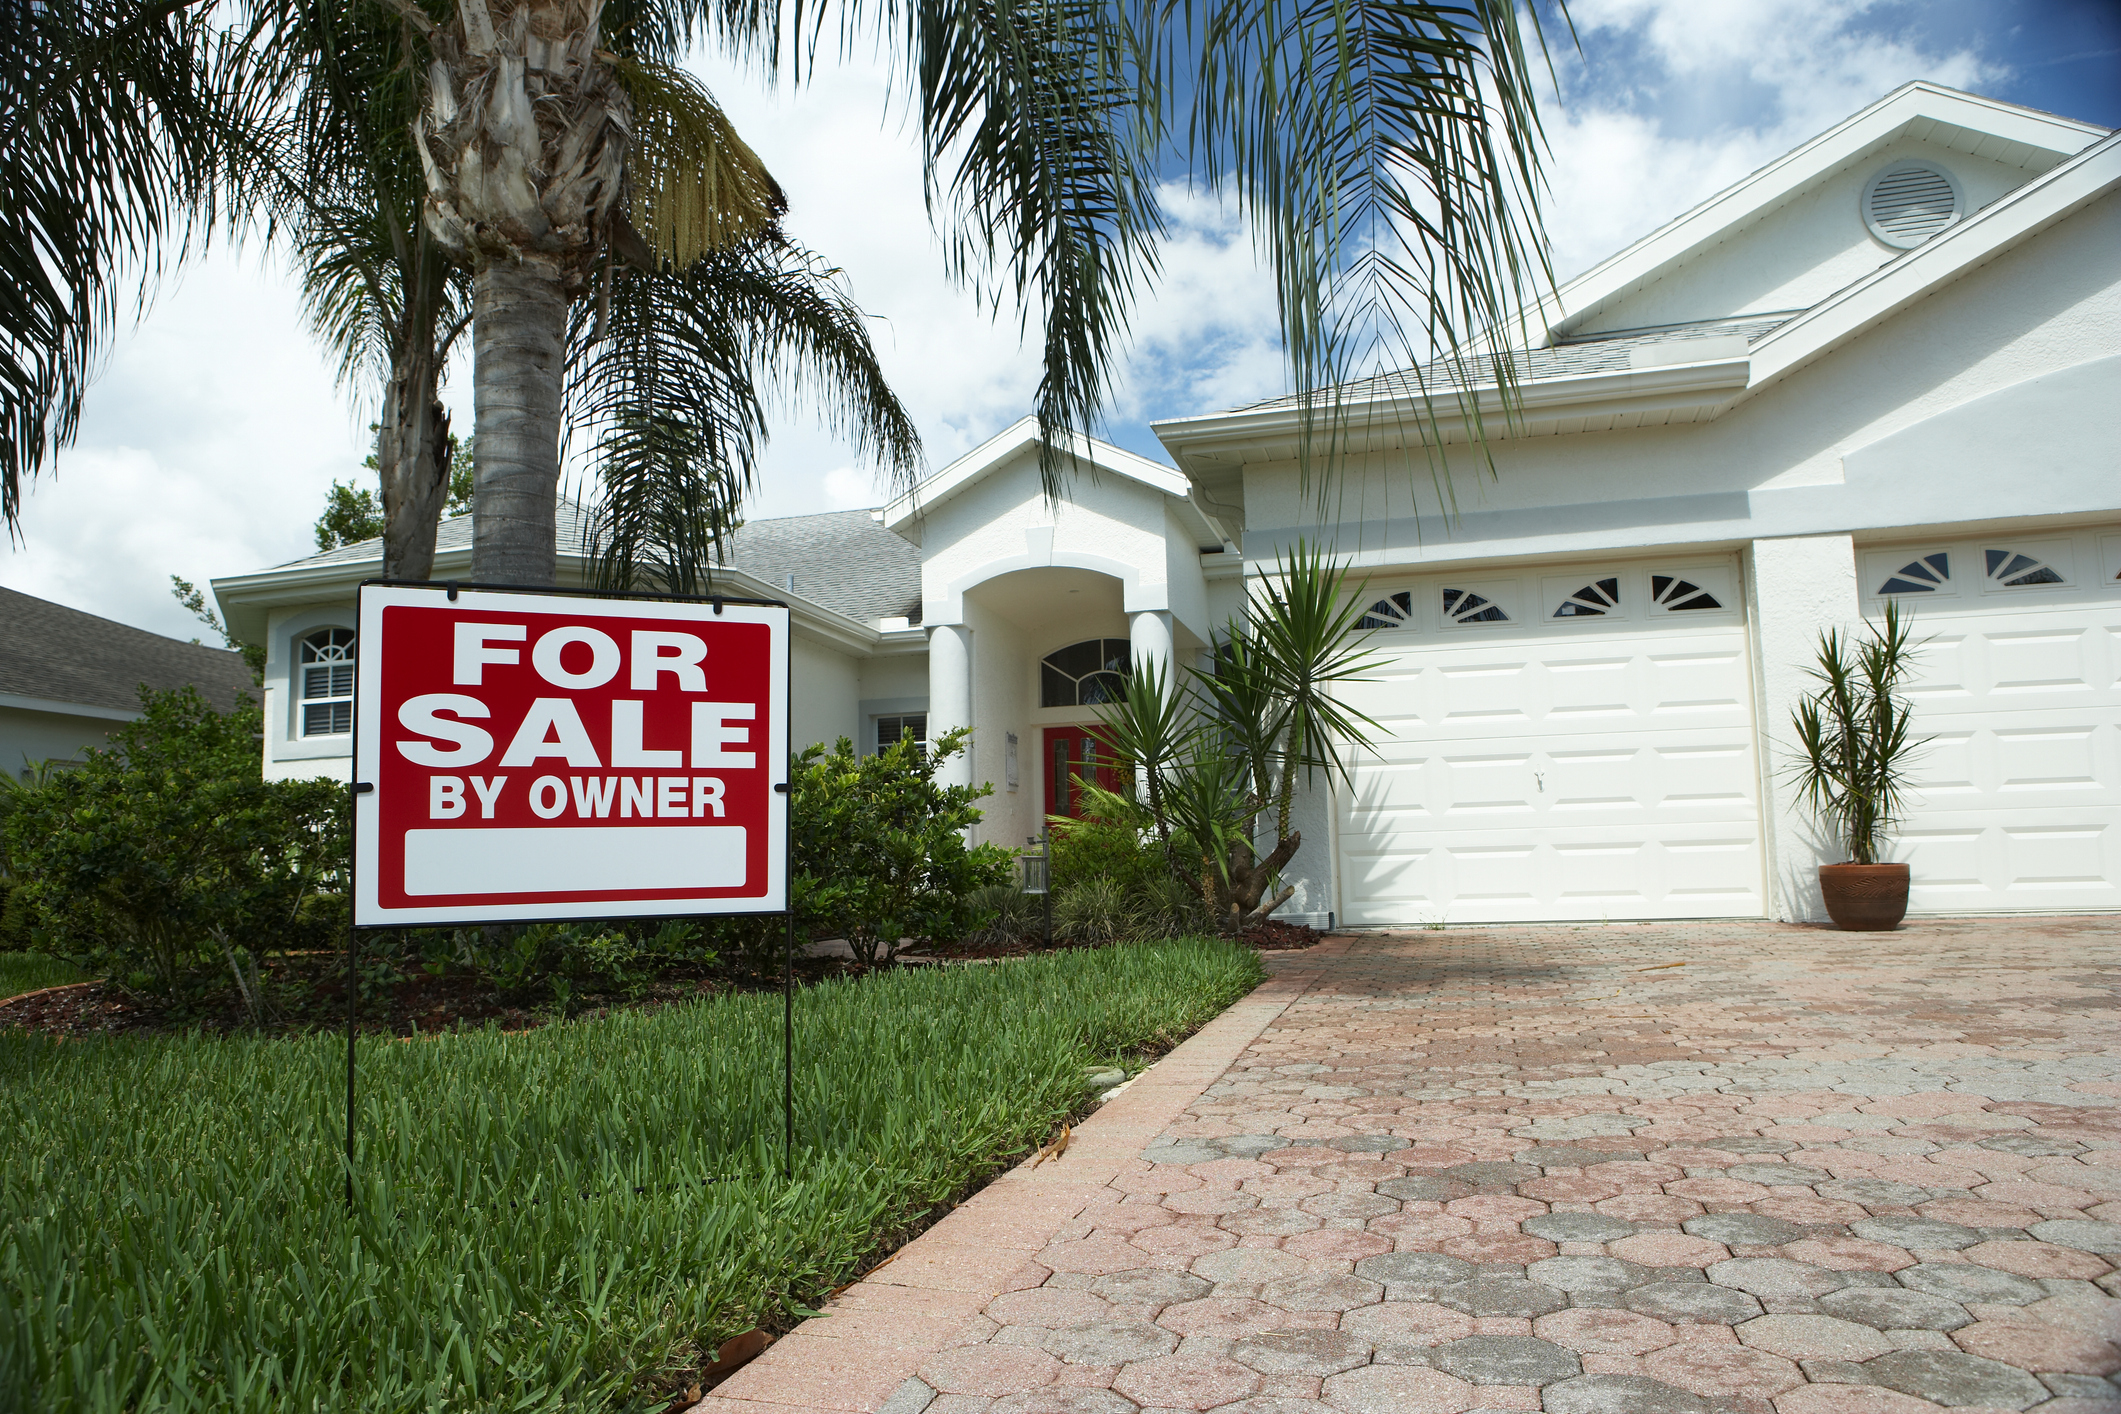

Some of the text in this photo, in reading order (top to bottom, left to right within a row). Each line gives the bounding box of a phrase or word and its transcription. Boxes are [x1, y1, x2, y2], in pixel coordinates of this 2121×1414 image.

[453, 621, 709, 692] FOR
[395, 693, 756, 769] SALE
[429, 775, 726, 820] BY OWNER
